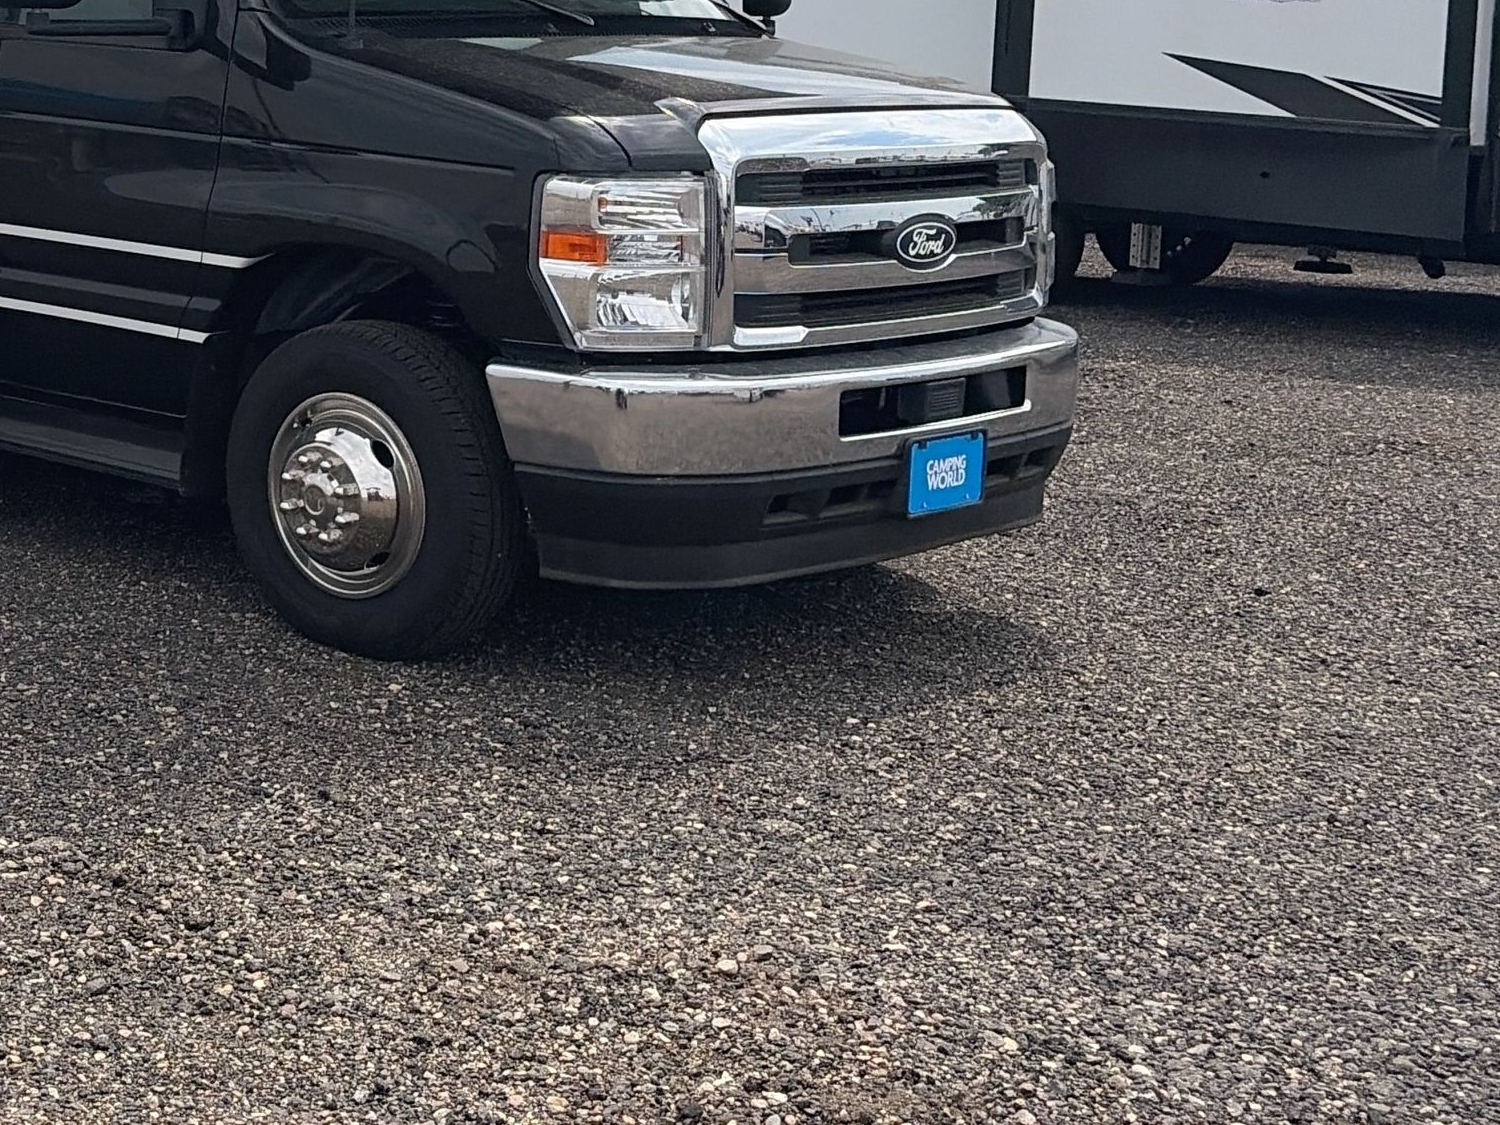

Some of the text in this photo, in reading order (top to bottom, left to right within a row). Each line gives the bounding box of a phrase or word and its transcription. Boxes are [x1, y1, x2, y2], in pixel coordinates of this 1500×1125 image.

[908, 228, 947, 257] Ford
[926, 454, 967, 475] CAMPING
[927, 469, 967, 491] WORLD
